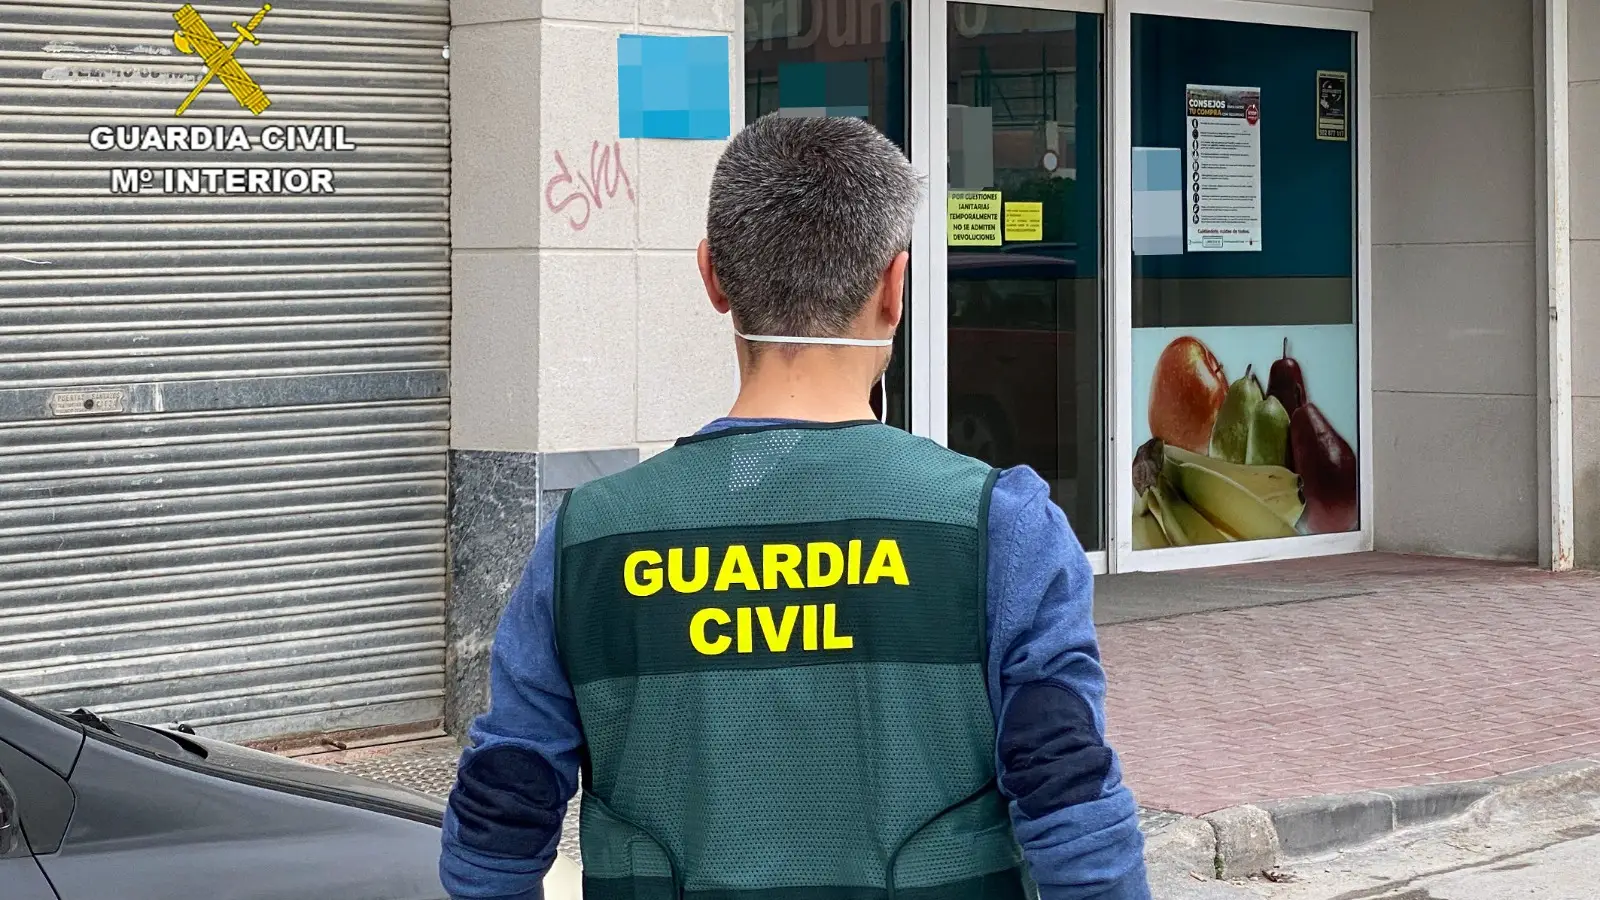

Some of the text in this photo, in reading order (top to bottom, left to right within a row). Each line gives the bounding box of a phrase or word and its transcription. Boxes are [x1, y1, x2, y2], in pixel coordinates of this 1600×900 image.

[1188, 99, 1226, 109] CONSEJOS
[1197, 108, 1222, 116] COMPRA
[624, 539, 910, 597] GUARDIA
[689, 603, 854, 656] CIVIL
